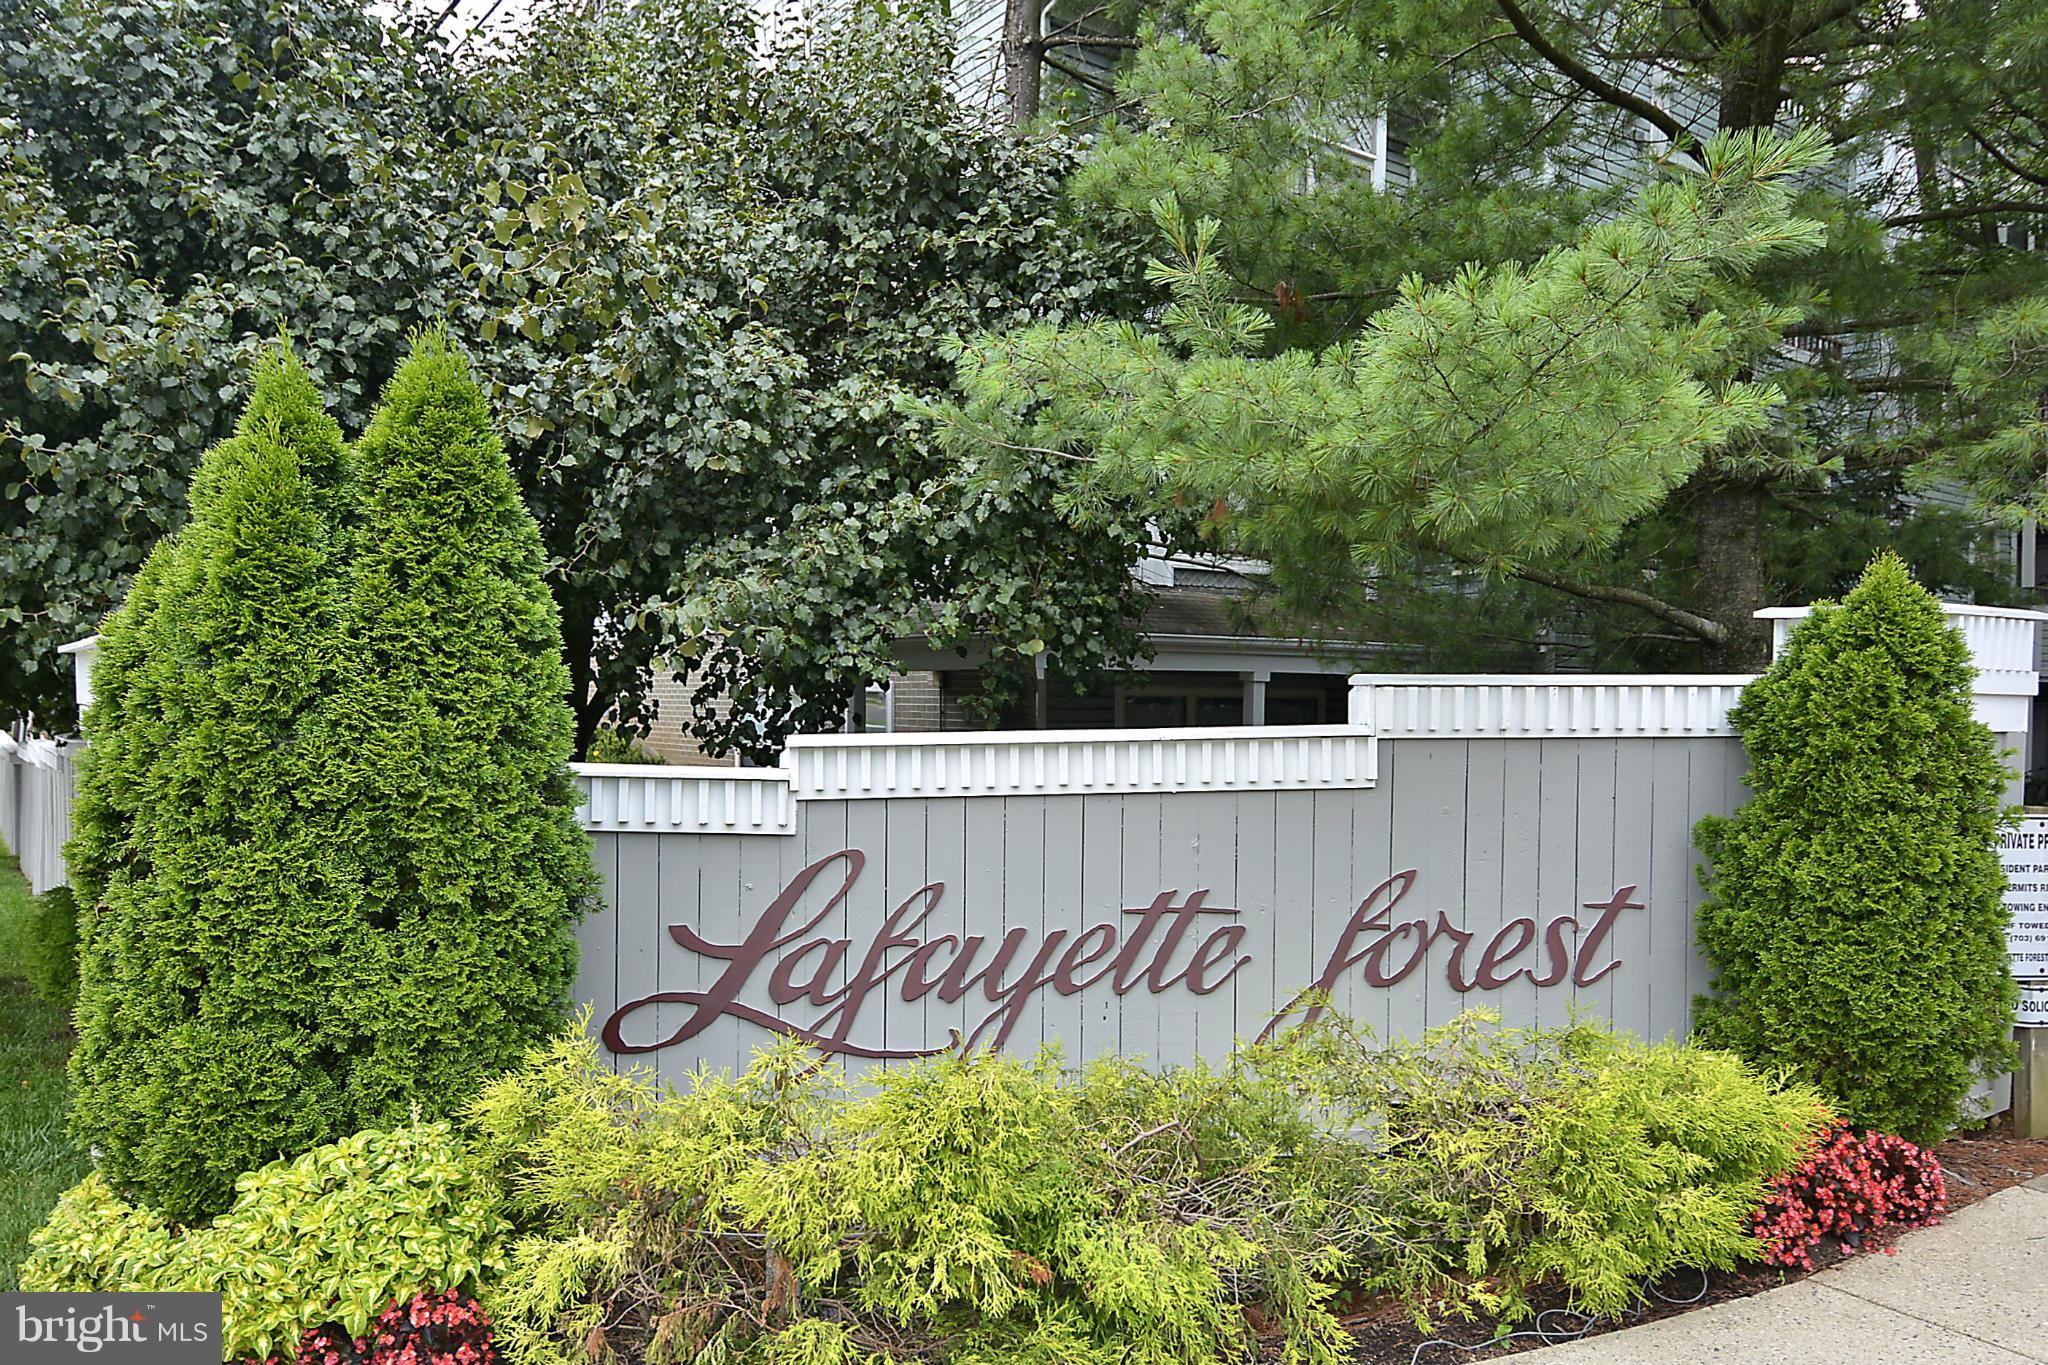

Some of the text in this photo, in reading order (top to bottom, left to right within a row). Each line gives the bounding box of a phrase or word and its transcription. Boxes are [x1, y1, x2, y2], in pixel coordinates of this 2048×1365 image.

[2010, 934, 2048, 943] (703) 69
[2025, 953, 2048, 962] FOREST
[601, 849, 1646, 1083] Lafayette forest
